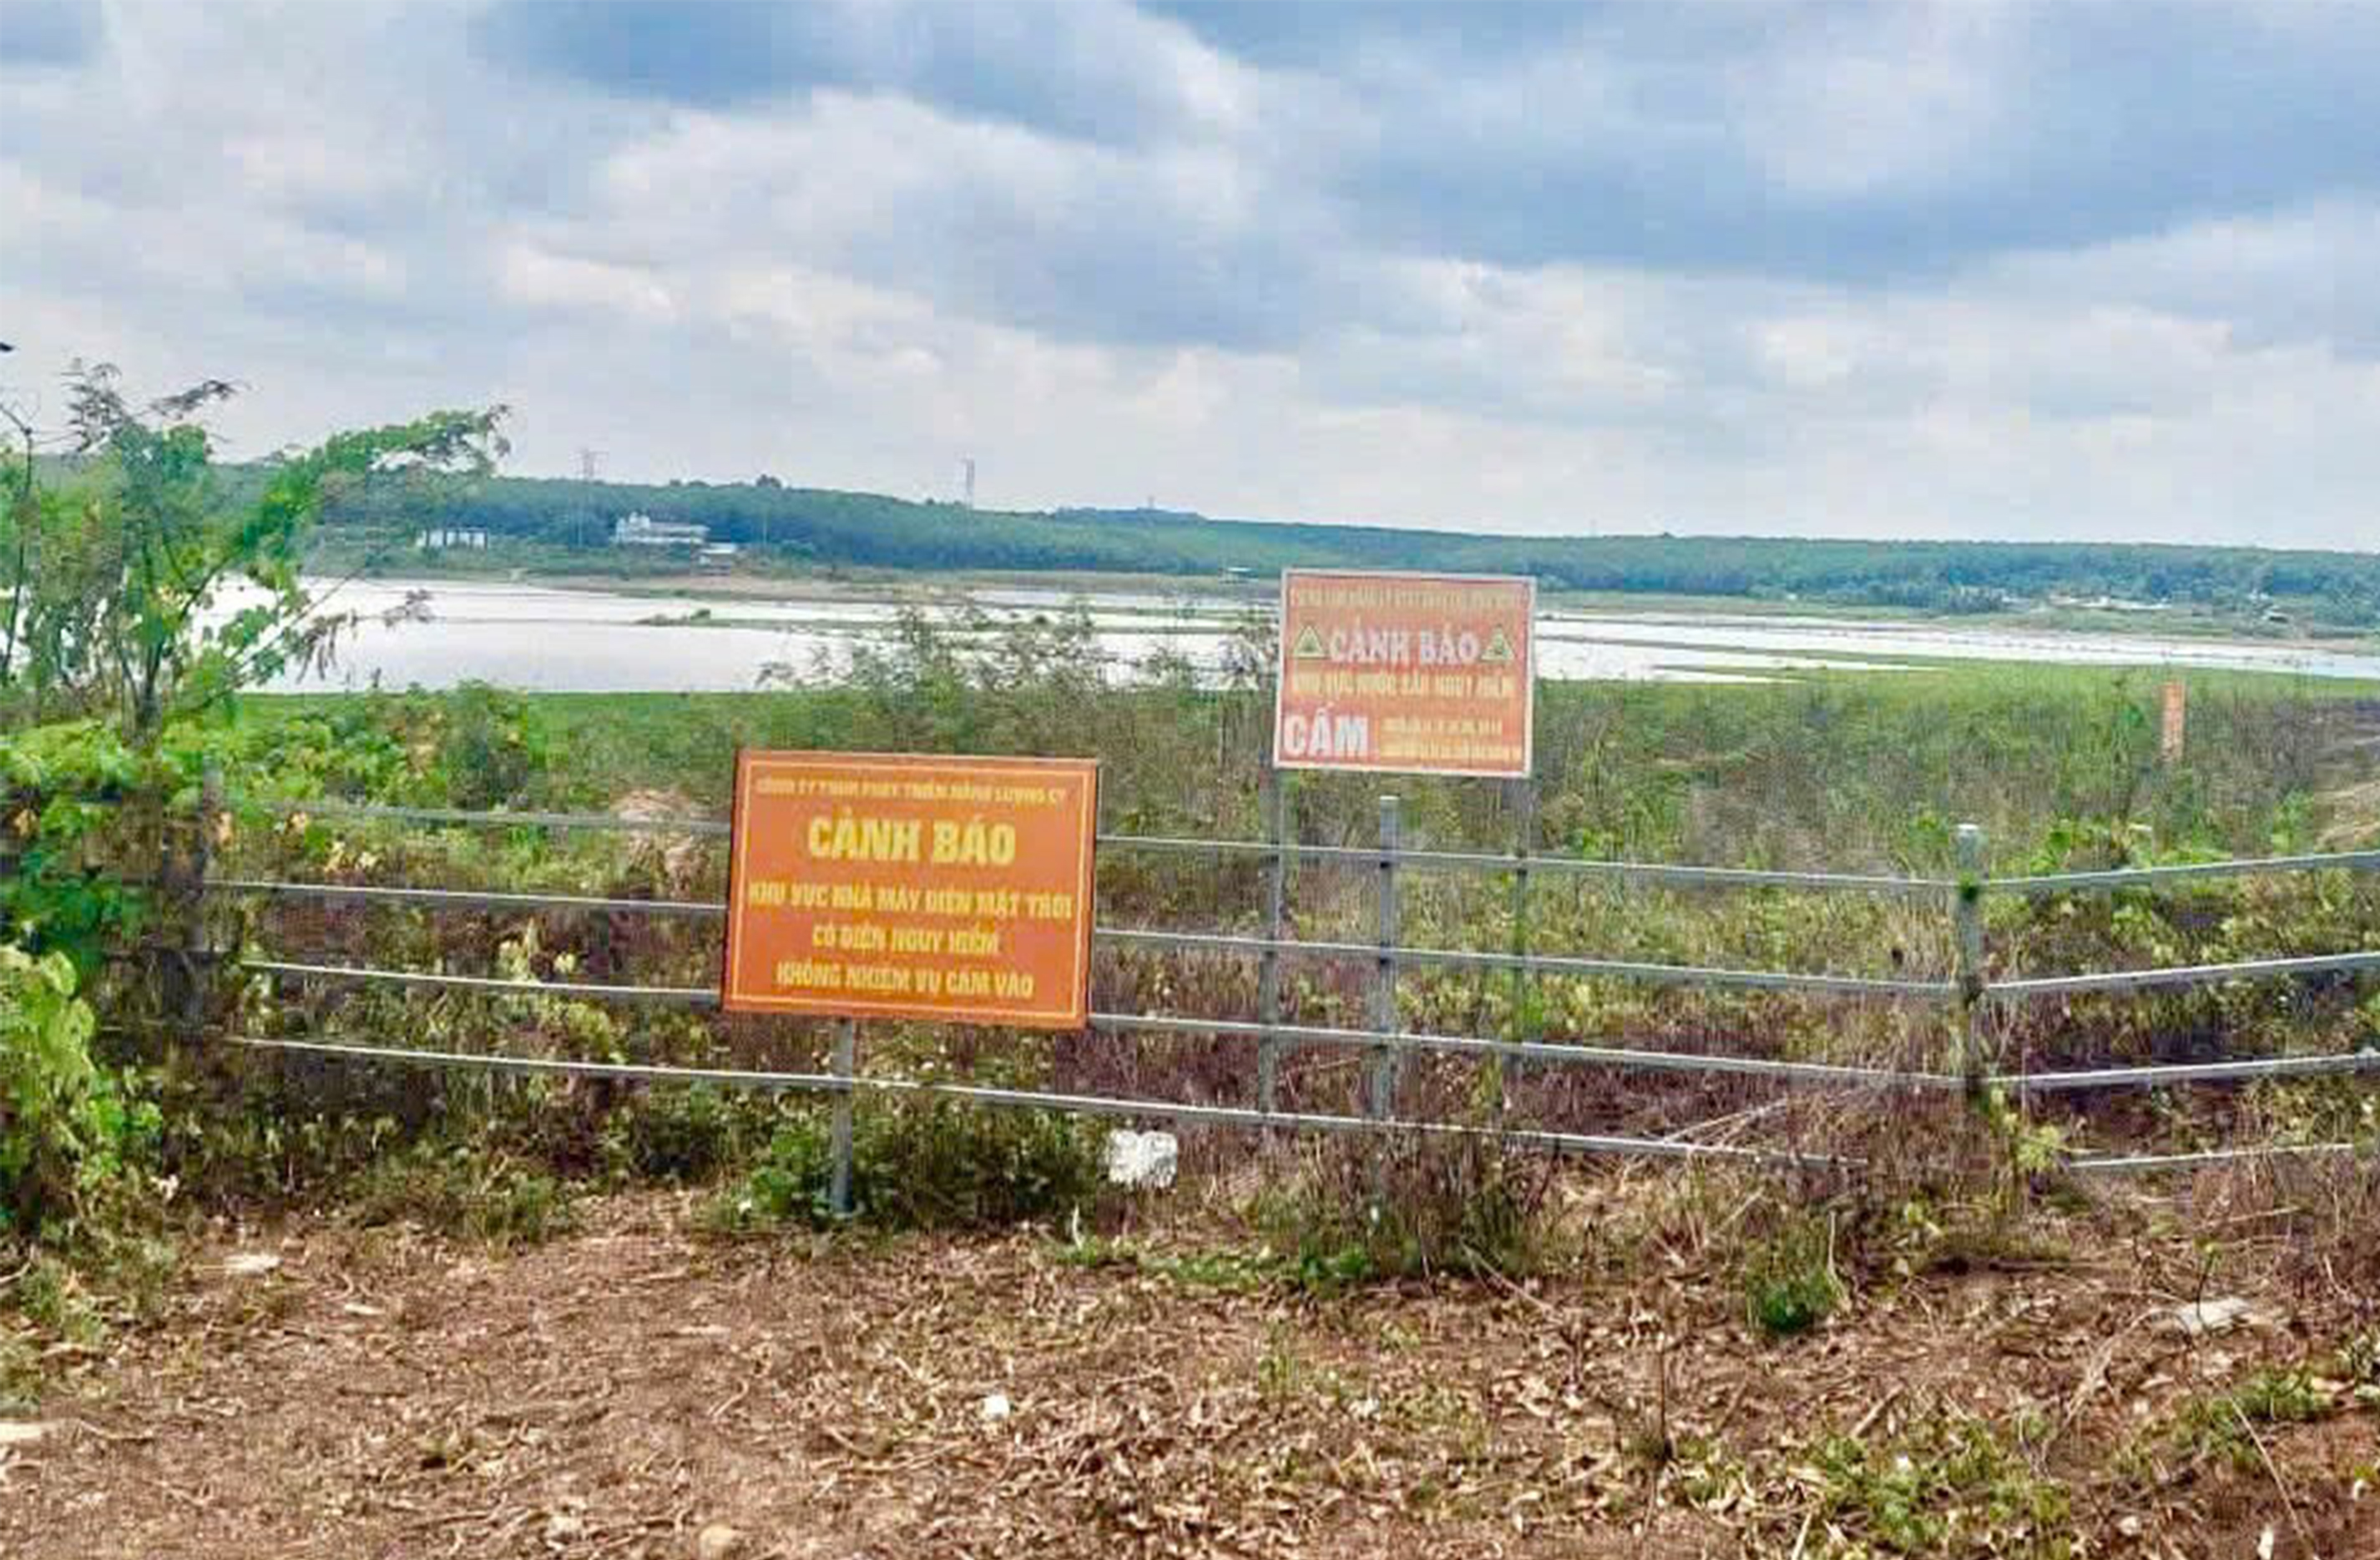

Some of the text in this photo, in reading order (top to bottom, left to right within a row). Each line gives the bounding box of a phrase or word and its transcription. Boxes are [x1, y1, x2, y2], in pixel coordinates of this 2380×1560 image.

[1419, 622, 1480, 665] BÁO
[1284, 700, 1370, 756] CẤM
[932, 813, 1016, 866] BÁO
